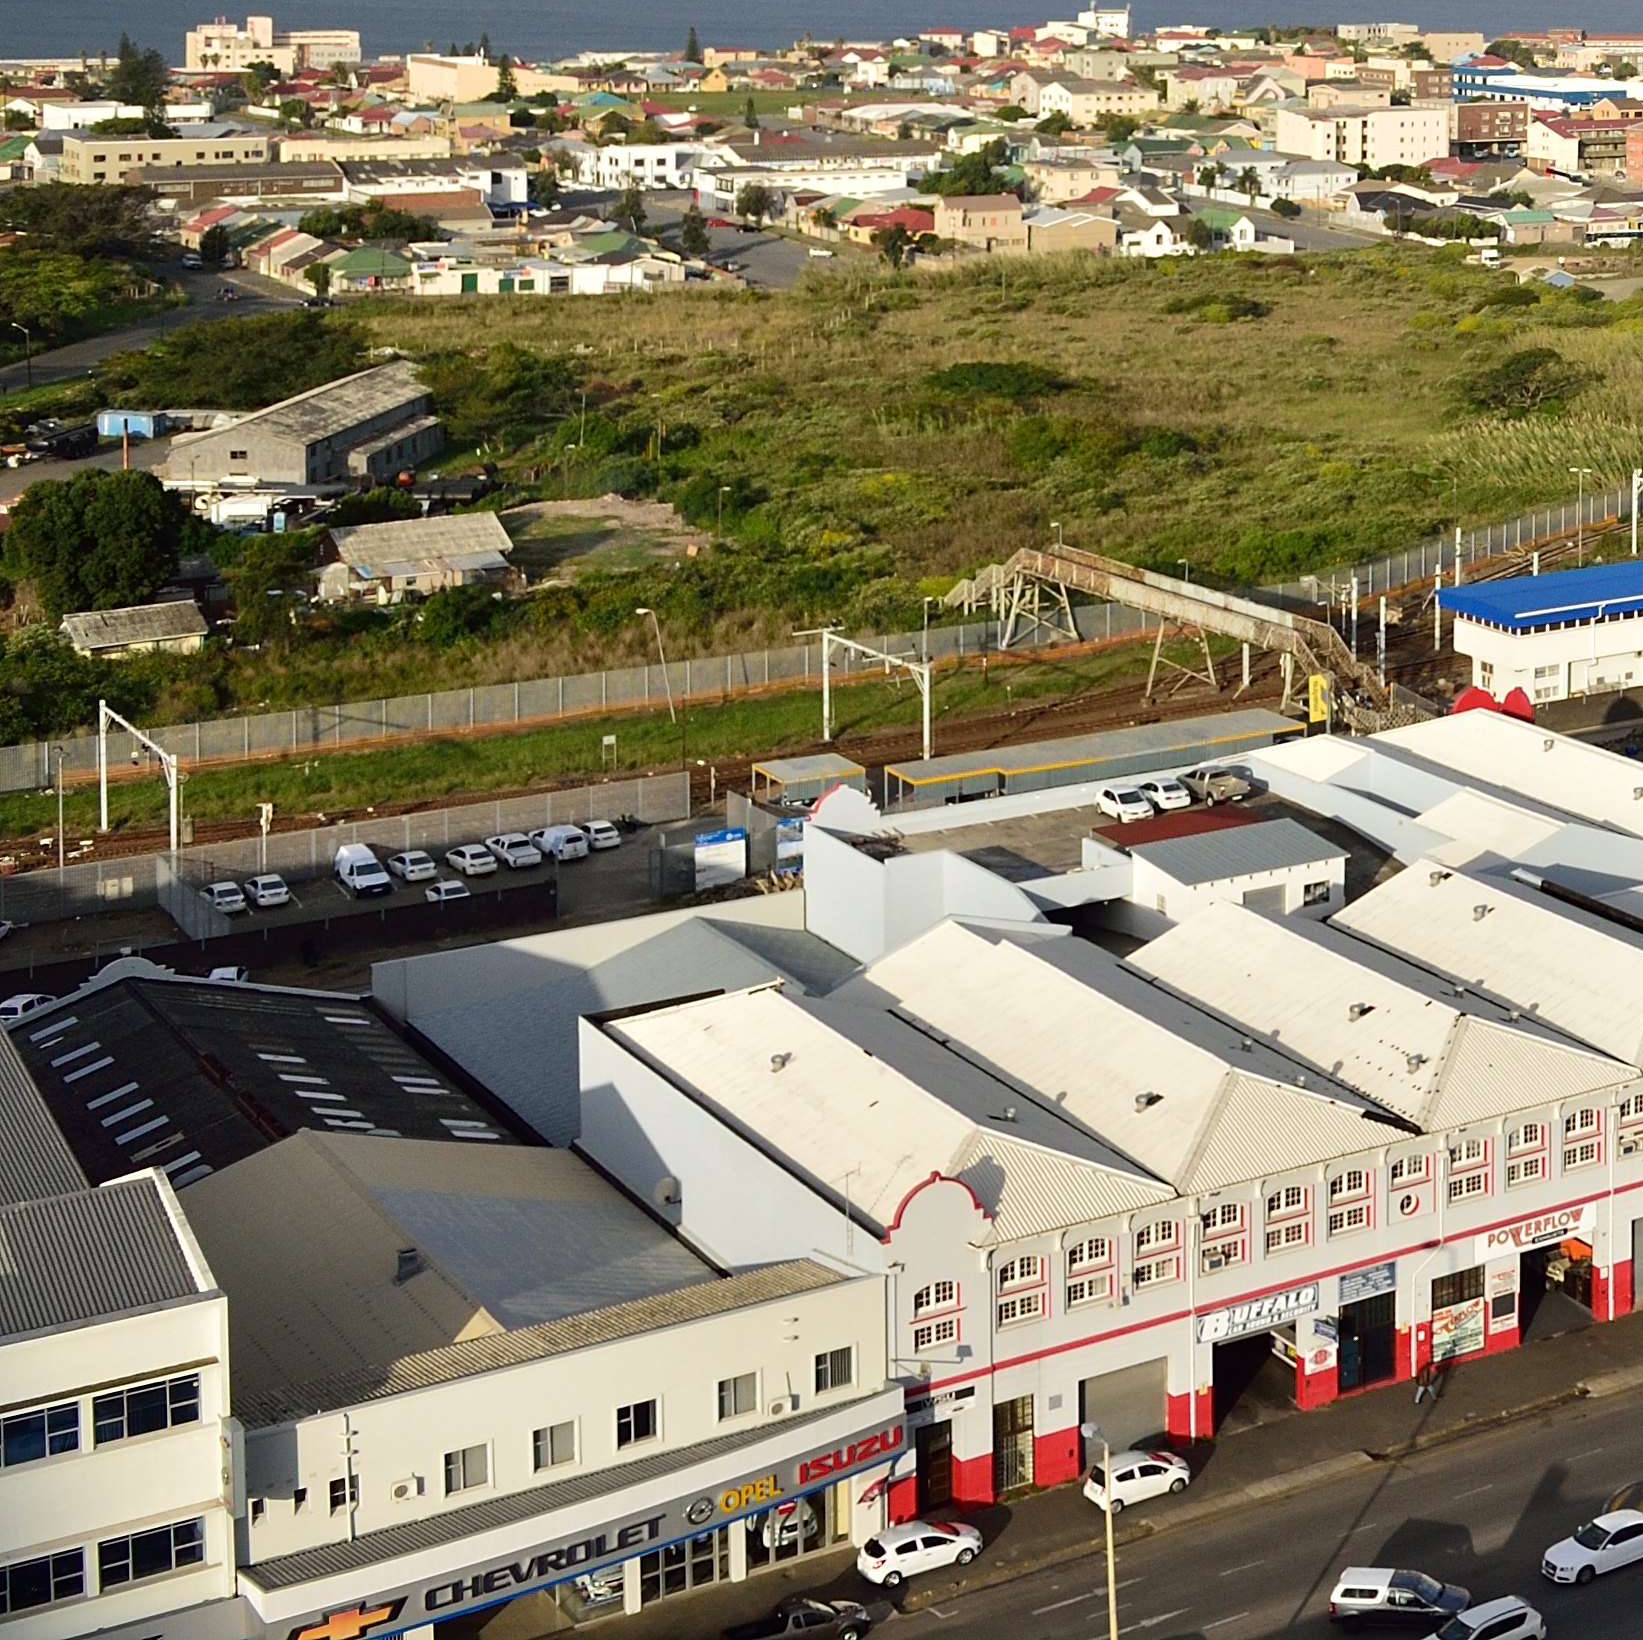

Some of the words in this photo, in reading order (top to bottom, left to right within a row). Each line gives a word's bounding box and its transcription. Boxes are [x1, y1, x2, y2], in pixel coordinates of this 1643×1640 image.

[1488, 1207, 1584, 1248] POWERFLOW
[1197, 1286, 1315, 1343] BUFFALO
[799, 1425, 904, 1486] ISUZU
[720, 1474, 783, 1514] OPEL
[425, 1513, 667, 1612] CHEVROLET
